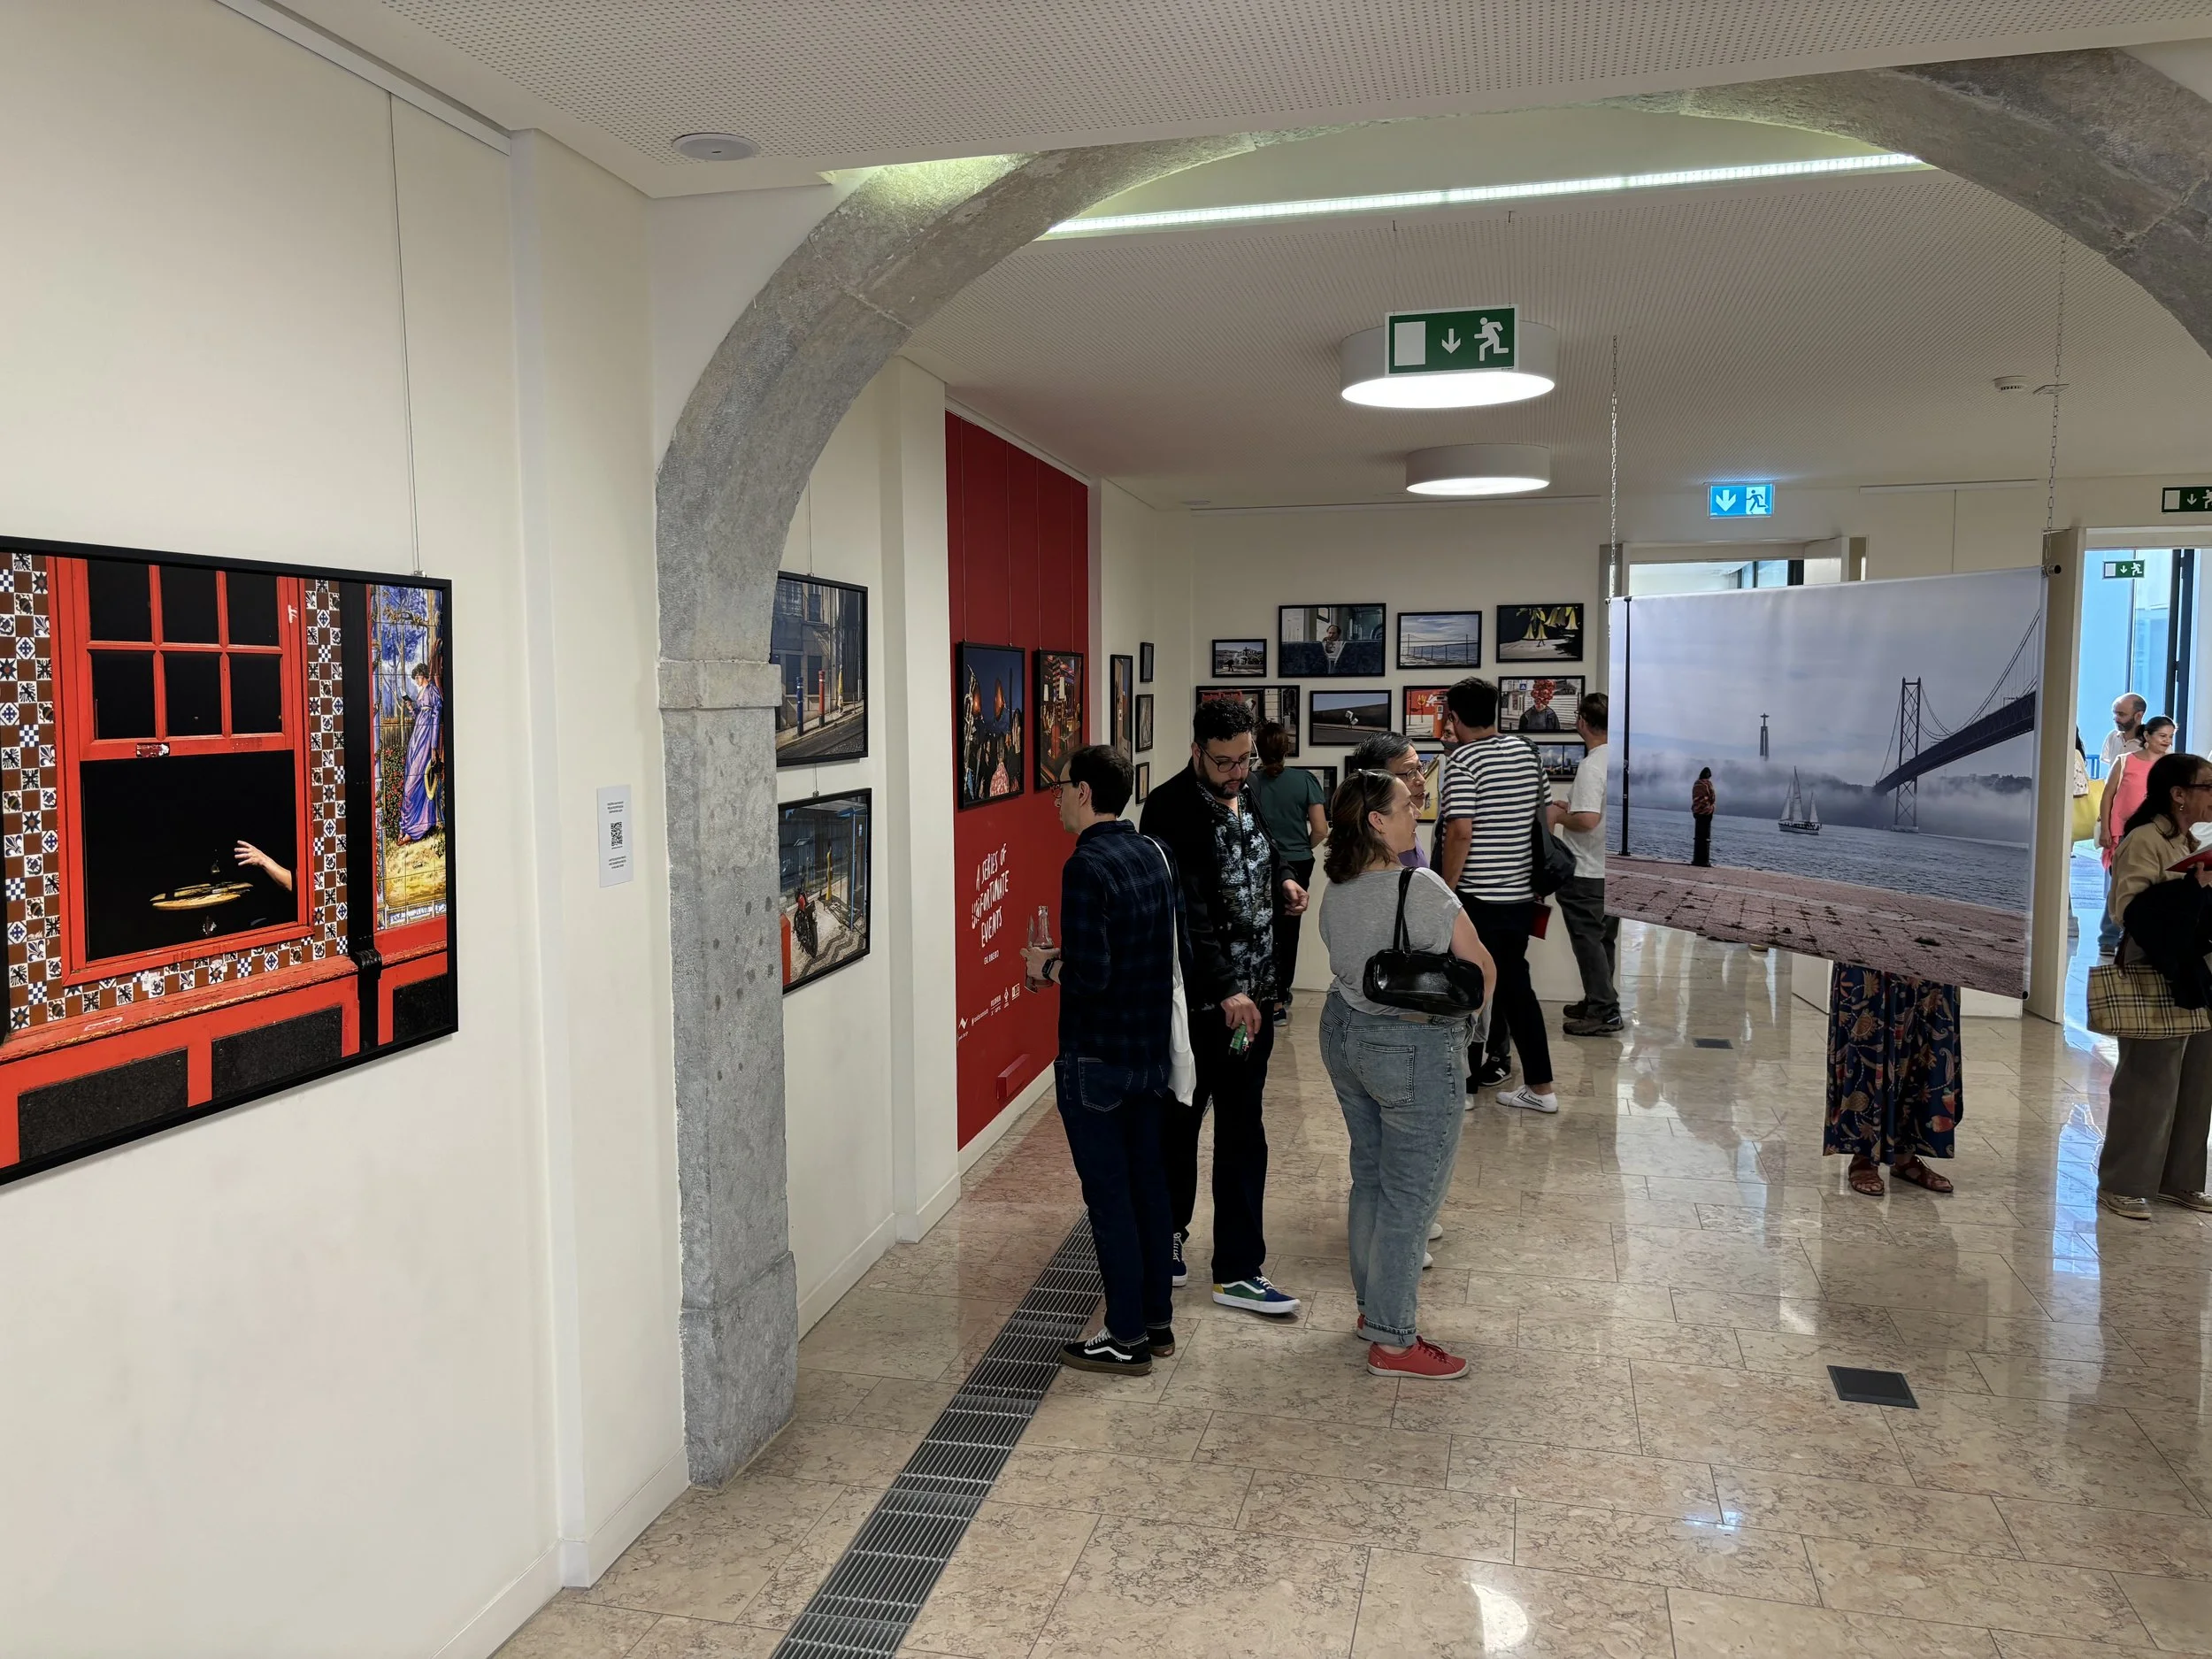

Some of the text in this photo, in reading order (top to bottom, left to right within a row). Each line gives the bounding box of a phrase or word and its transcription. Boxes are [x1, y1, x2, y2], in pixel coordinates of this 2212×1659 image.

[976, 842, 1007, 891] A SERIES OF
[972, 870, 1009, 929] UNFORTUNATE
[981, 905, 1002, 948] EVENTS
